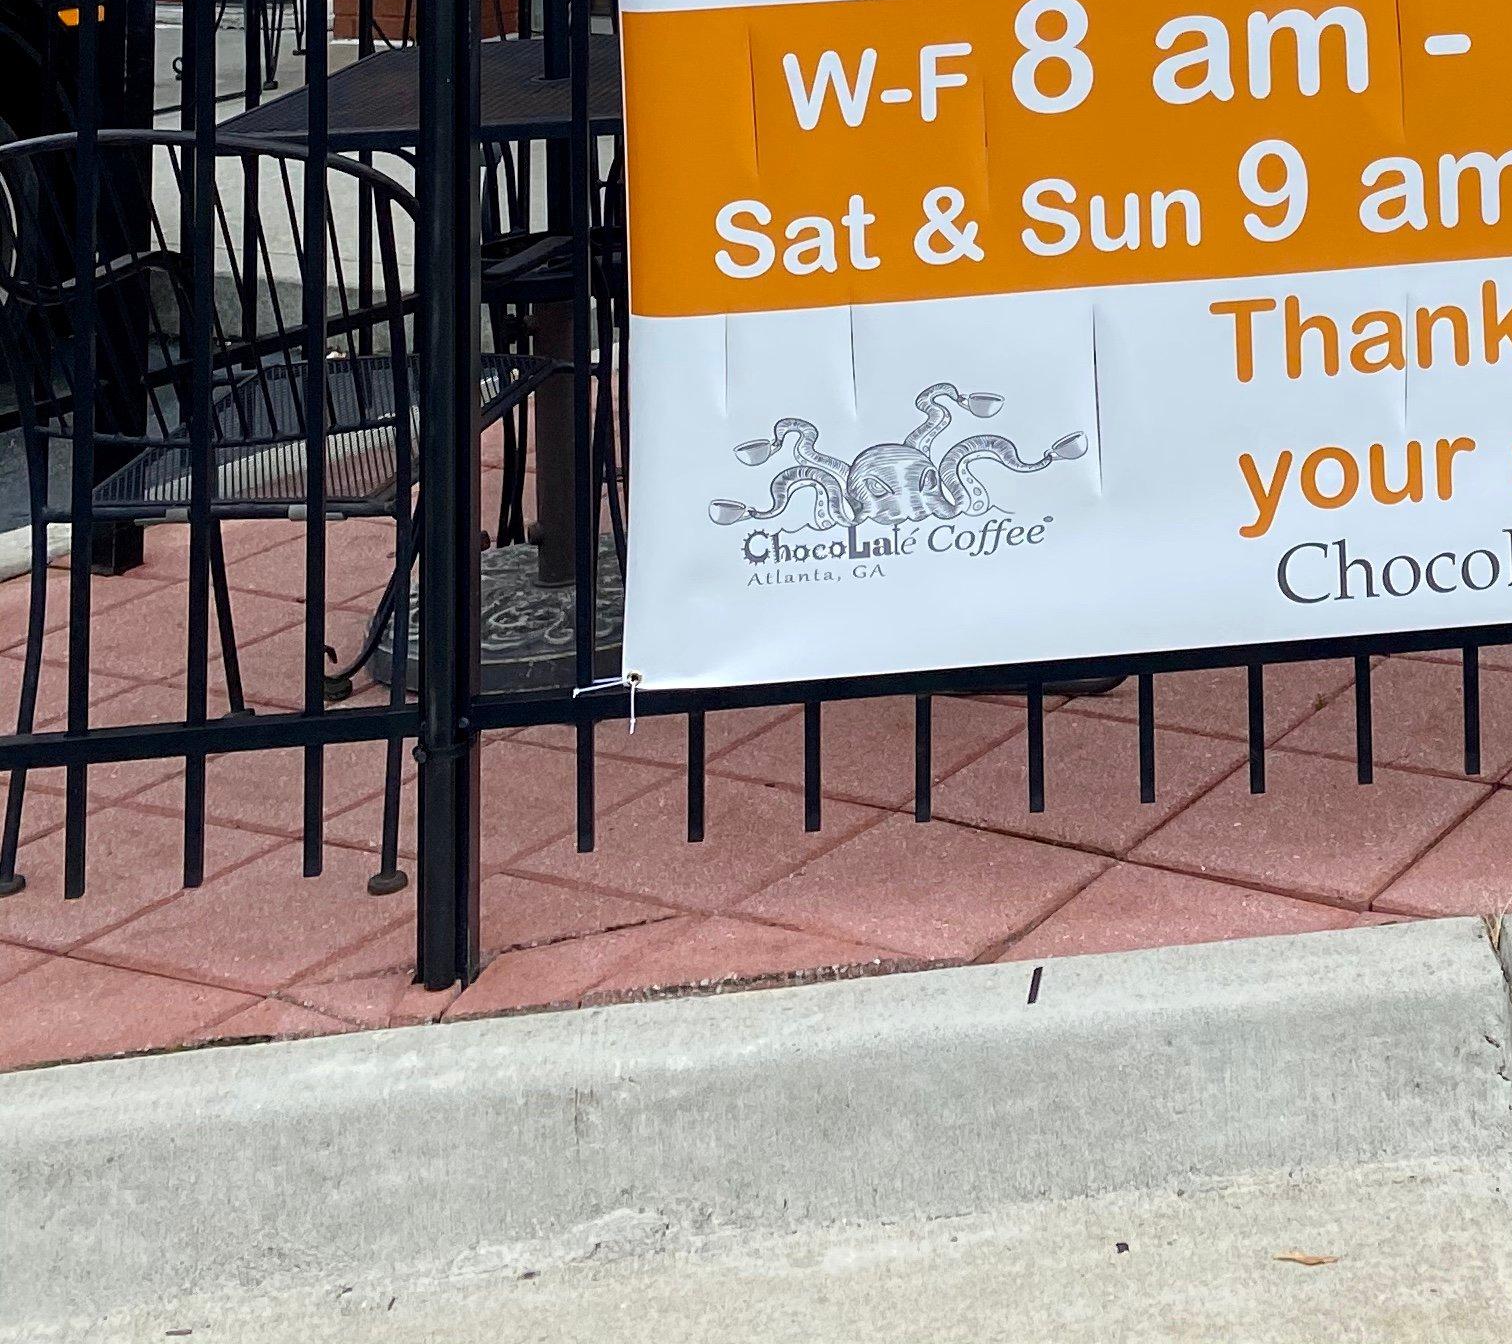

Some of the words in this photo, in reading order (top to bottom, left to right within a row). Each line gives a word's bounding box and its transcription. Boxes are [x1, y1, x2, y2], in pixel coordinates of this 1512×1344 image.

[781, 41, 973, 132] W-F
[1151, 4, 1370, 106] am
[1423, 33, 1472, 56] -
[713, 193, 881, 280] Sat
[912, 185, 985, 265] &
[1020, 176, 1202, 258] Sun
[1236, 138, 1310, 244] 9
[927, 519, 1046, 559] Coffee
[1237, 433, 1476, 540] your
[745, 568, 844, 588] Atlanta,
[851, 563, 886, 580] GA
